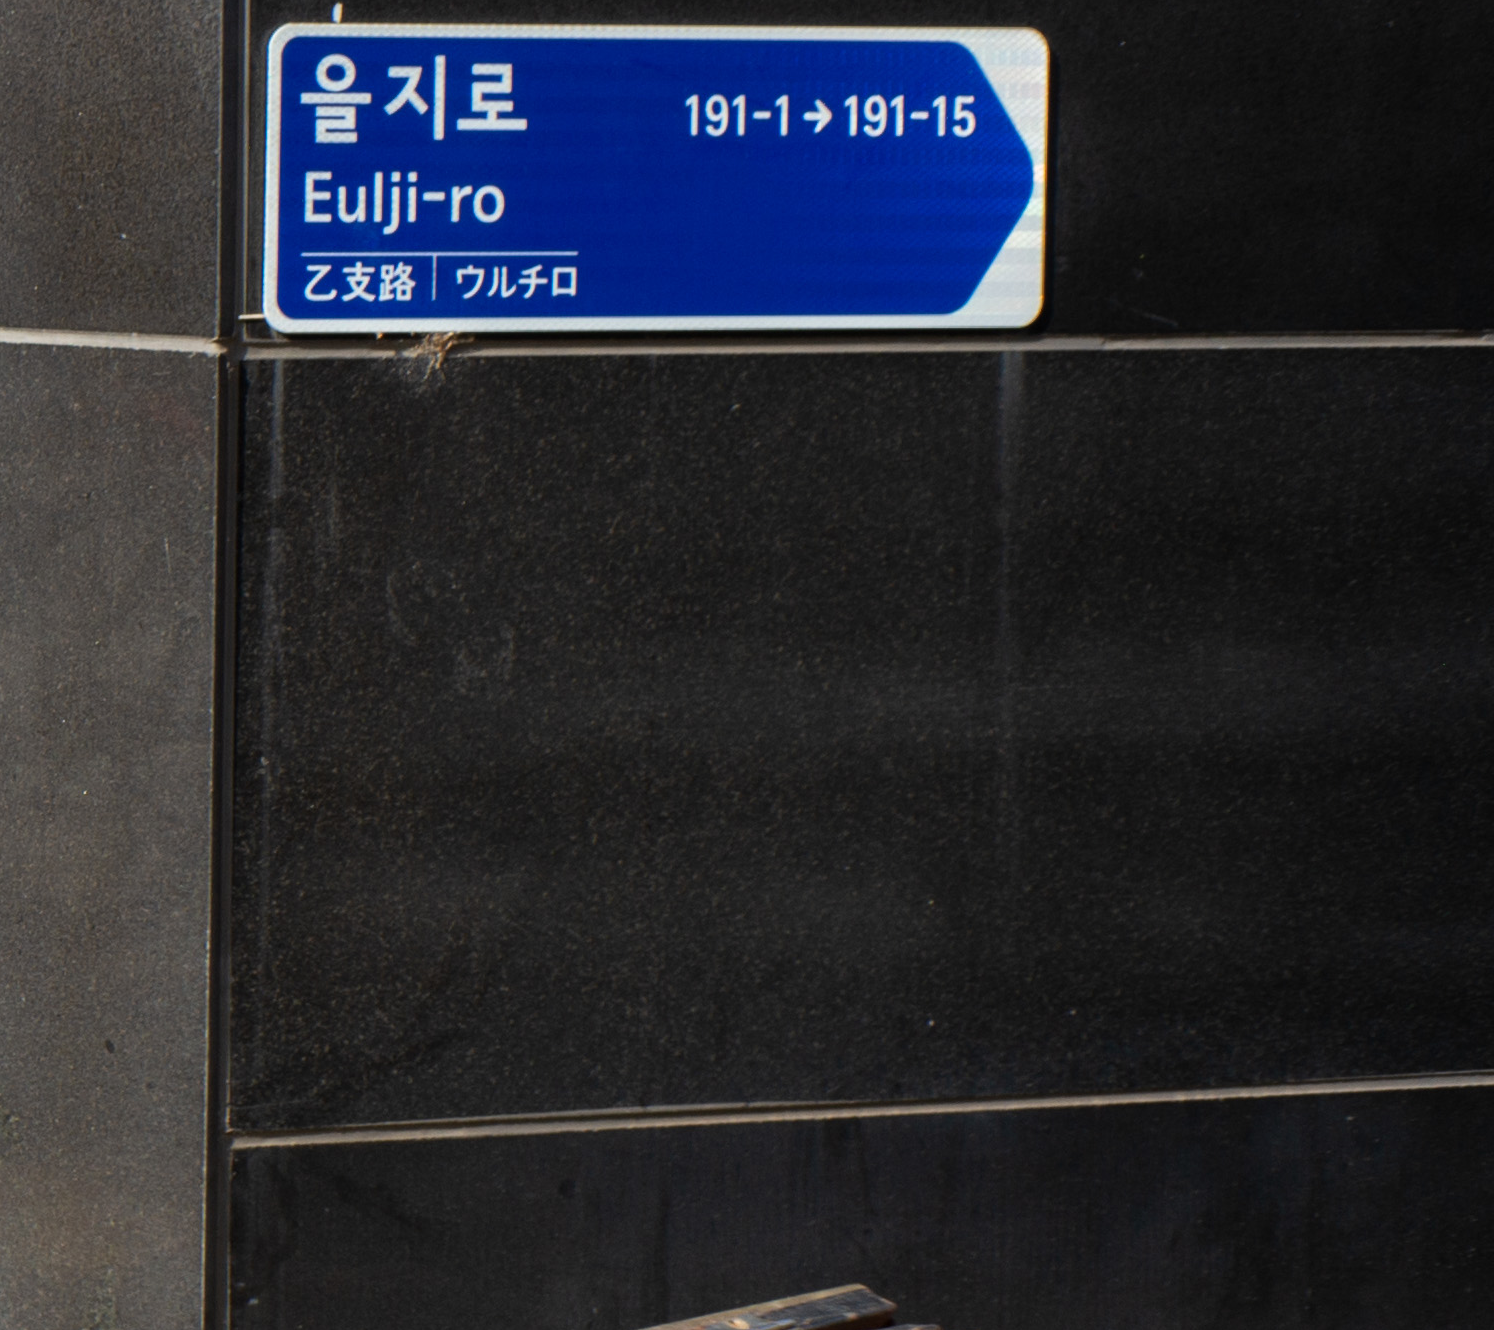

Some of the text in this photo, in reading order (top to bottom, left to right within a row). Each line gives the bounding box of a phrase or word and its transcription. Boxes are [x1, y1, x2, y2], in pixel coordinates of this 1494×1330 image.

[300, 53, 528, 144] 을지로
[685, 94, 977, 138] 191-1 191-15
[302, 171, 506, 235] Eulji-ro
[302, 264, 417, 303] 乙支路
[456, 266, 579, 300] ウルチロ
